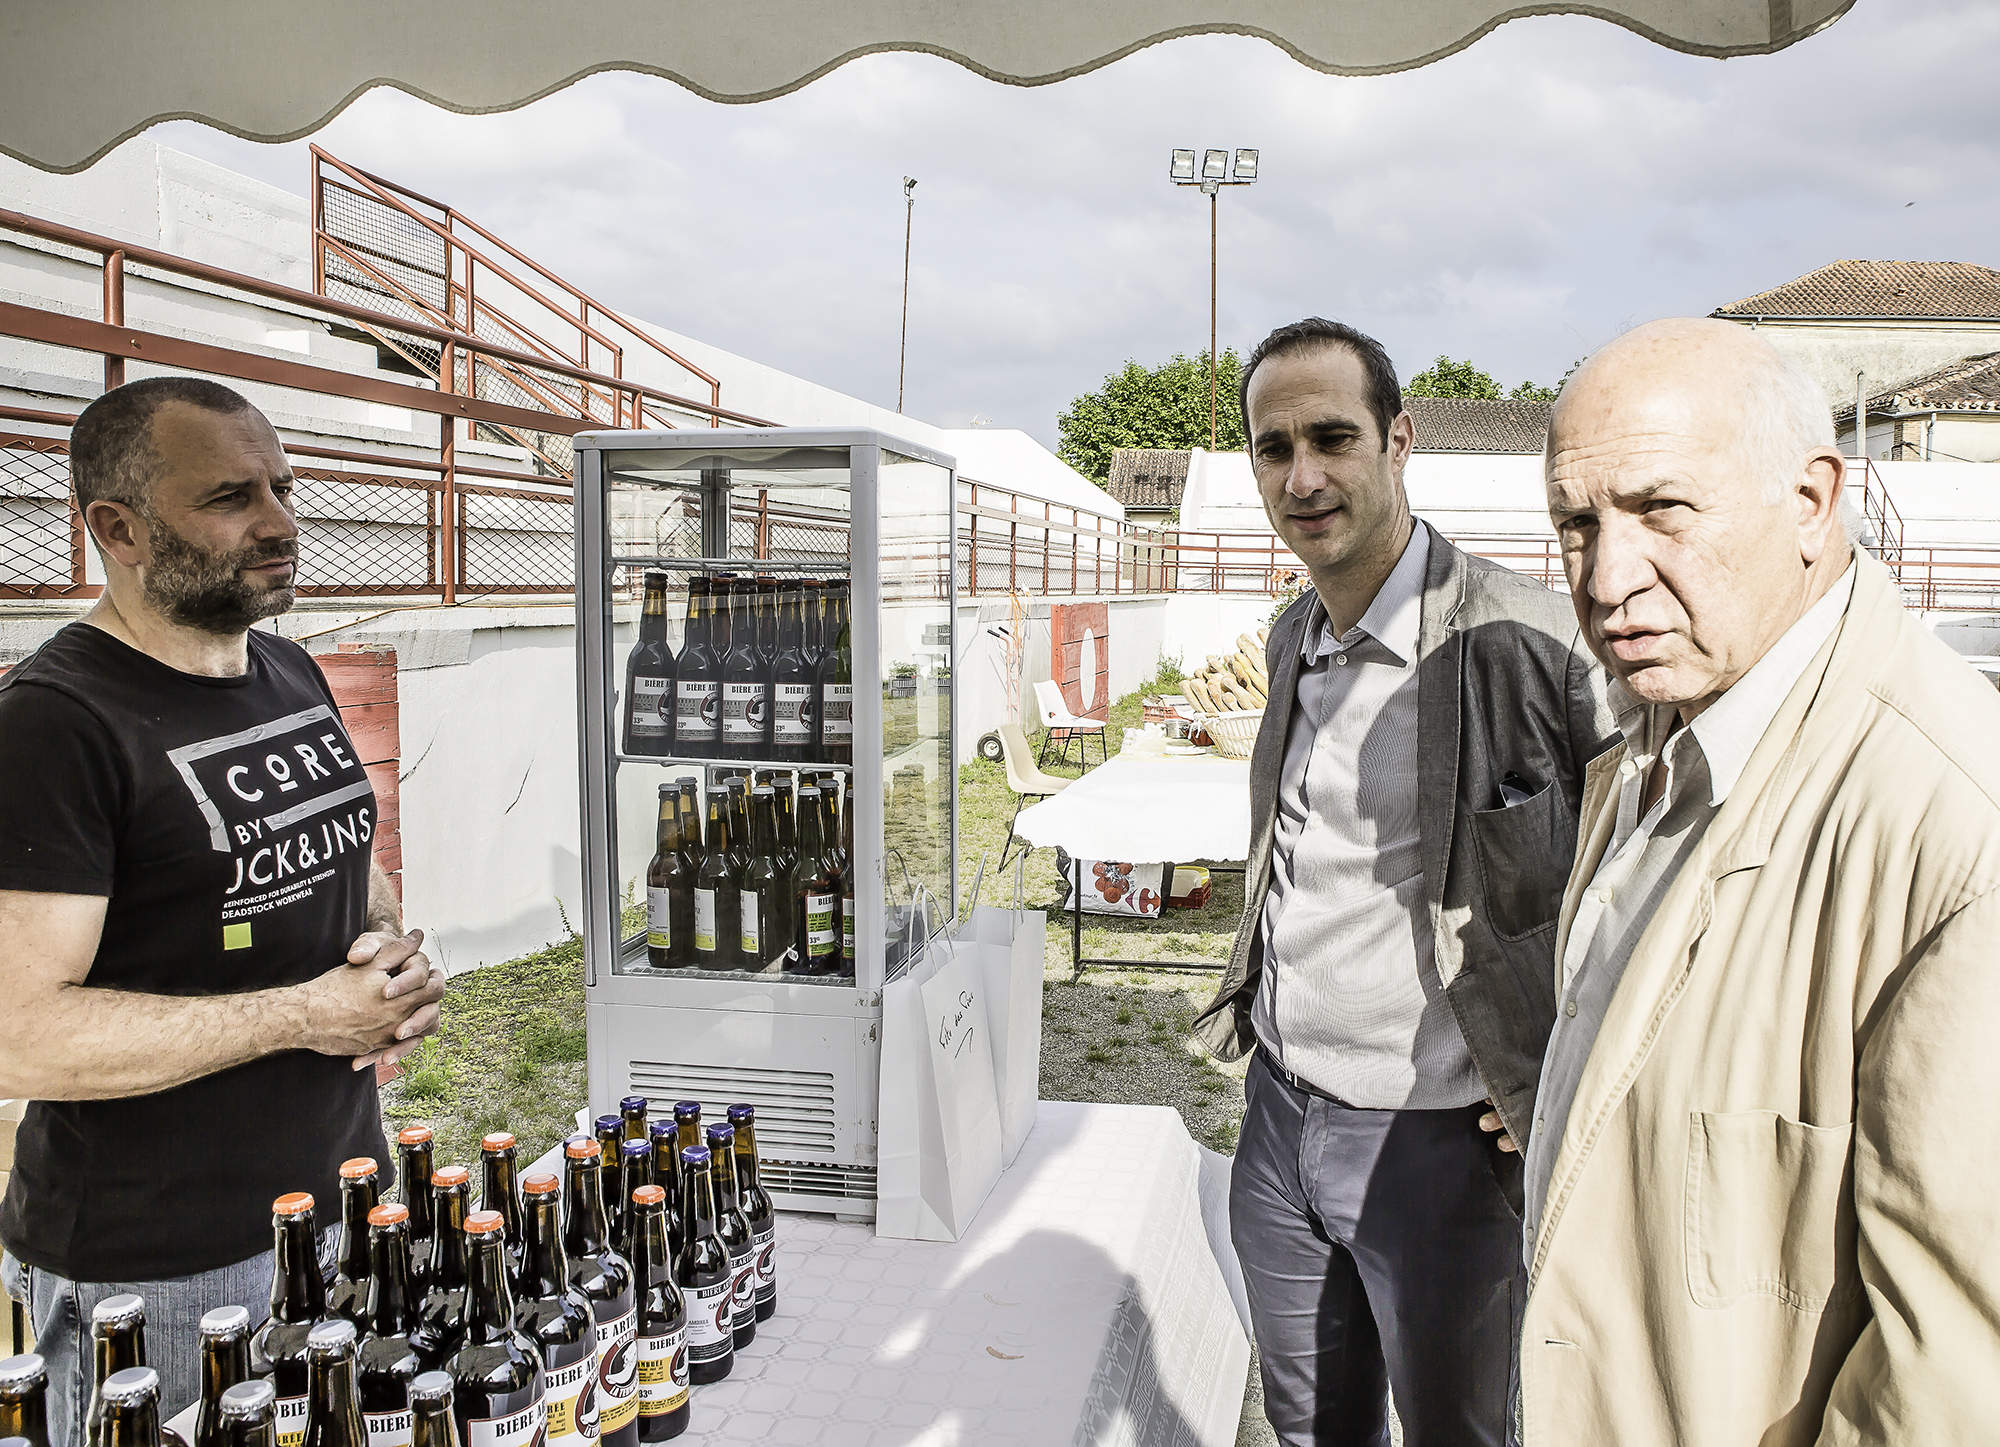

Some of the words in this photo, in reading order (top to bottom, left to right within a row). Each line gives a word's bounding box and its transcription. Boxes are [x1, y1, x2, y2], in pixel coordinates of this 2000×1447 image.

[686, 683, 706, 691] BIÈRE
[731, 685, 752, 693] BIÈRE
[753, 686, 764, 694] ART
[226, 733, 354, 803] CORE
[234, 818, 262, 846] BY
[225, 807, 371, 895] JCK&JNS
[223, 894, 267, 909] REINFORCED
[268, 889, 280, 899] FOR
[280, 879, 307, 895] DURABILITY
[312, 868, 336, 883] STRENGTH
[221, 901, 275, 920] DEADSTOCK
[275, 887, 314, 907] WORKWEAR
[613, 1312, 636, 1337] ARTIS
[650, 1335, 676, 1351] BIÈRE
[545, 1365, 583, 1389] BIÈRE
[280, 1398, 309, 1418] BIÈ
[547, 1402, 565, 1413] RÉE
[370, 1414, 413, 1434] BIÈRE
[495, 1410, 535, 1438] BIÈRE
